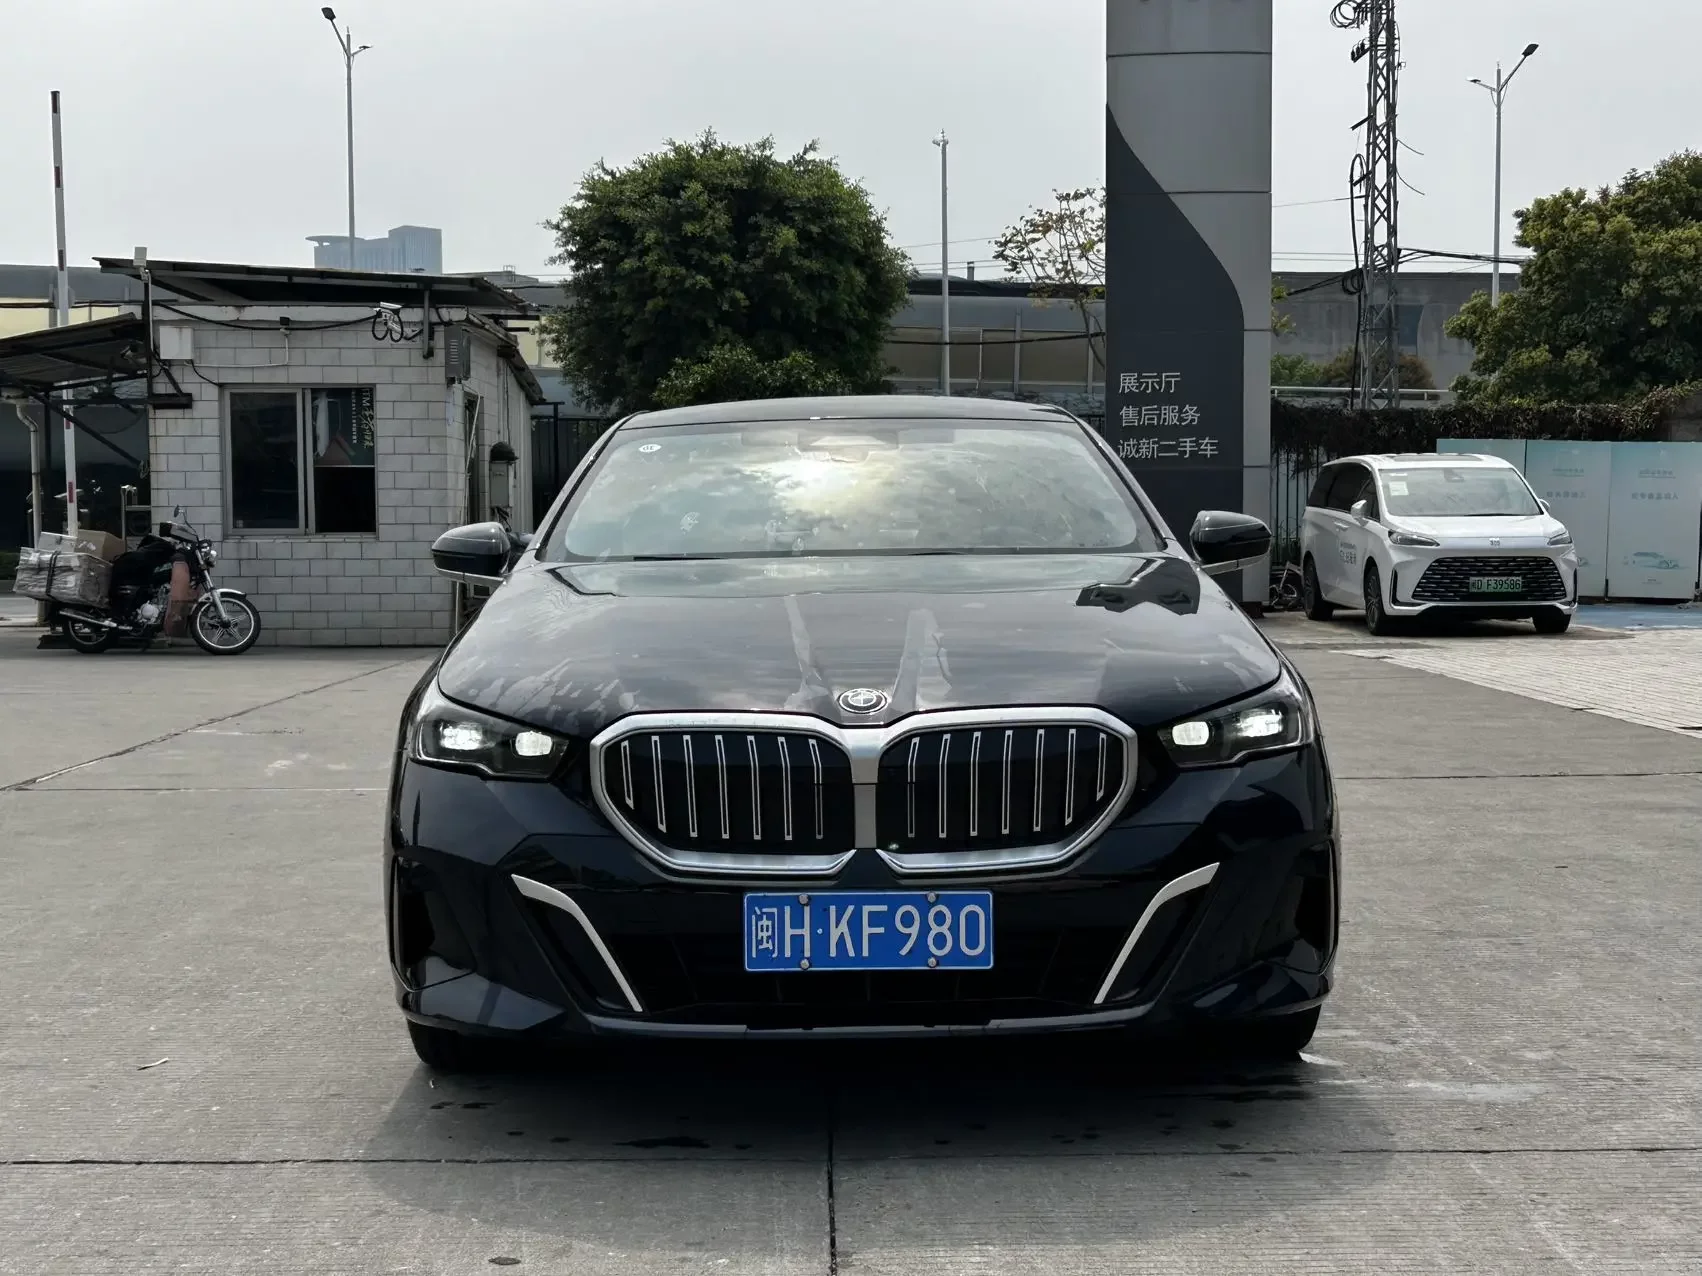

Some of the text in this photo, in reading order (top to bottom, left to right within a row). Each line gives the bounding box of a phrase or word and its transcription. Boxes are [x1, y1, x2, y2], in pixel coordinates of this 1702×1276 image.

[1118, 371, 1181, 394] 展示厅
[1119, 404, 1201, 427] 售后服务
[1117, 436, 1219, 459] 诚新二手车
[751, 903, 986, 958] 闽H·KF980
